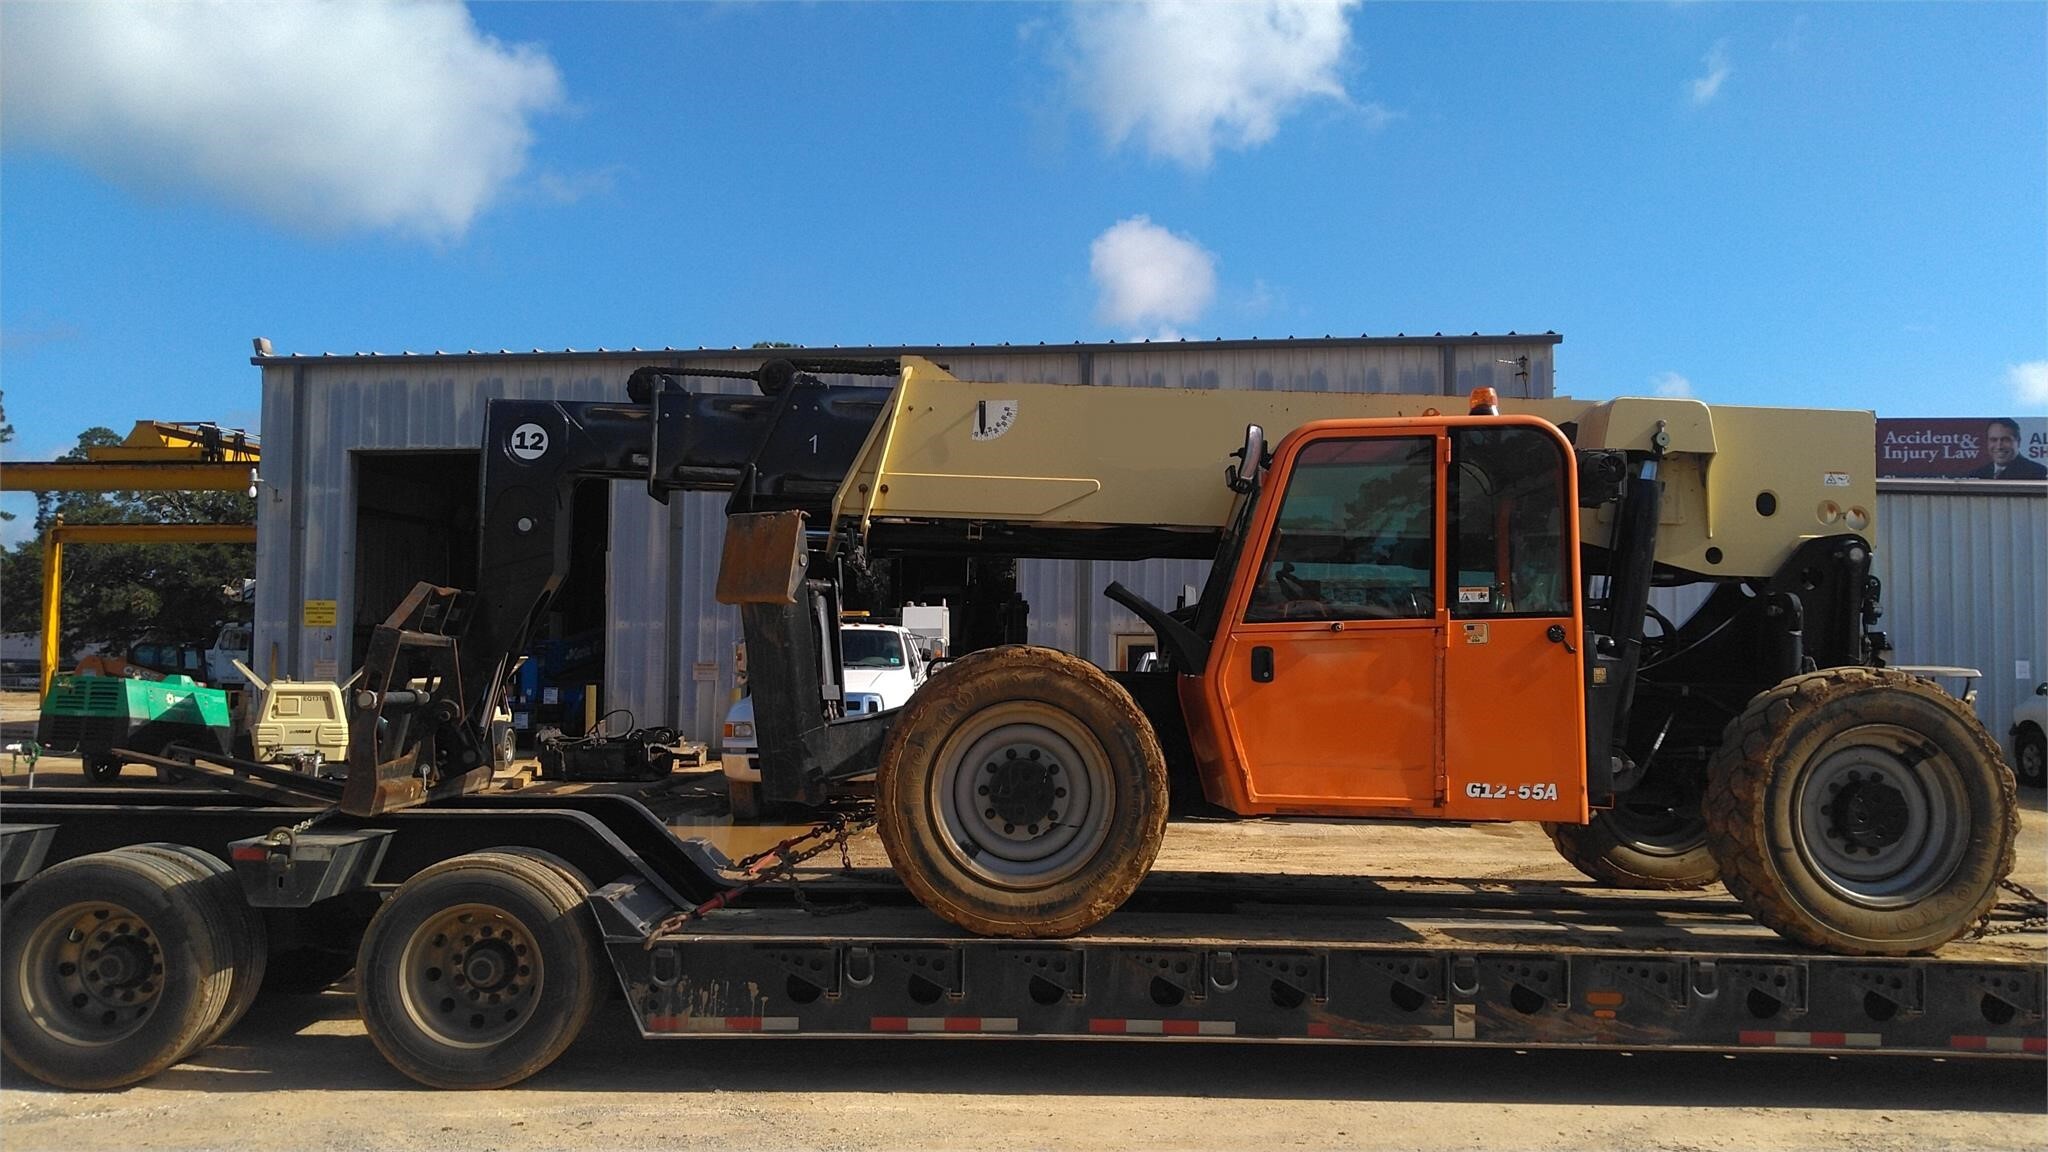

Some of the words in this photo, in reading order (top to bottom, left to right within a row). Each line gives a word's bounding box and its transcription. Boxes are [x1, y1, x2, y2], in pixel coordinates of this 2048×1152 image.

[515, 431, 544, 451] 12
[809, 434, 818, 454] 1
[1883, 430, 1959, 444] Accident
[1883, 446, 1939, 463] Injury
[1944, 445, 1980, 460] Law
[1466, 782, 1558, 801] G12-55A
